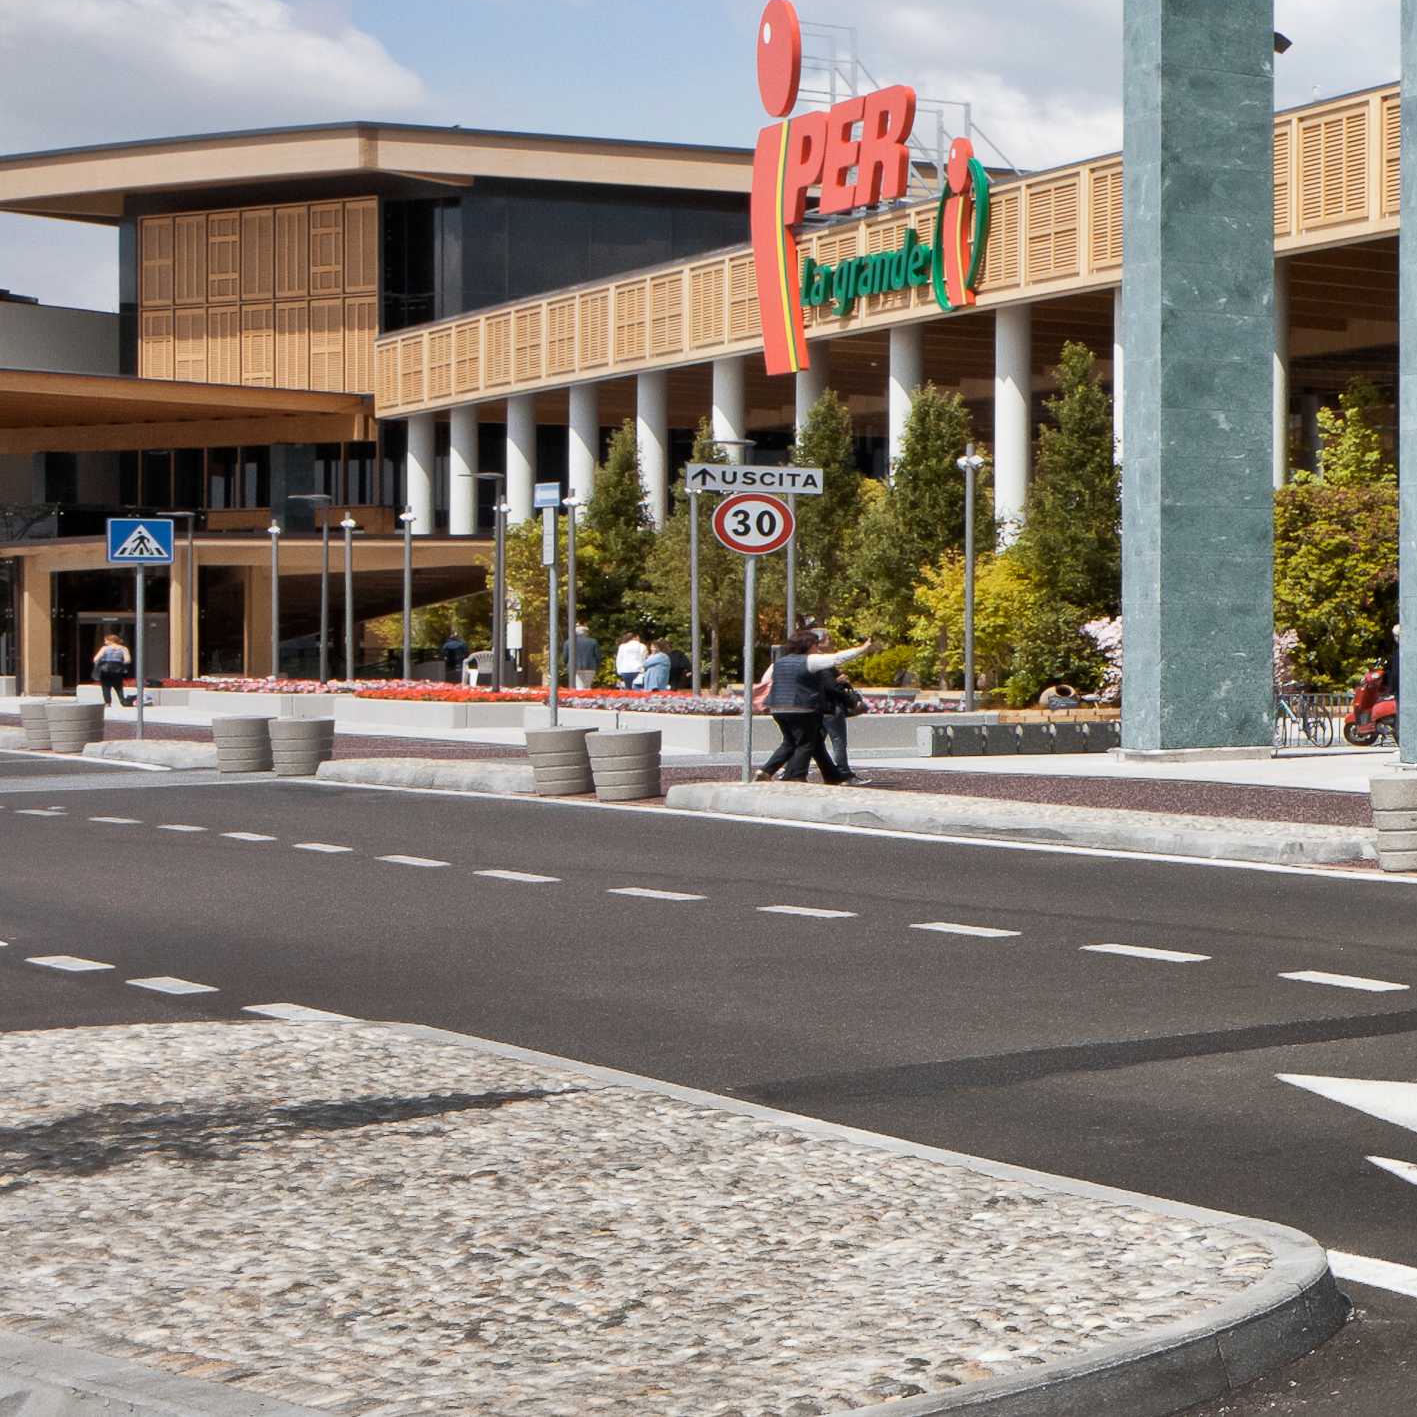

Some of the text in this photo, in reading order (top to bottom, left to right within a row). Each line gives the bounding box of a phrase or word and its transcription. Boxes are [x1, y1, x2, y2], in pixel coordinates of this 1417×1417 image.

[832, 228, 930, 317] grande
[721, 470, 818, 488] USCITA
[731, 509, 777, 537] 30
